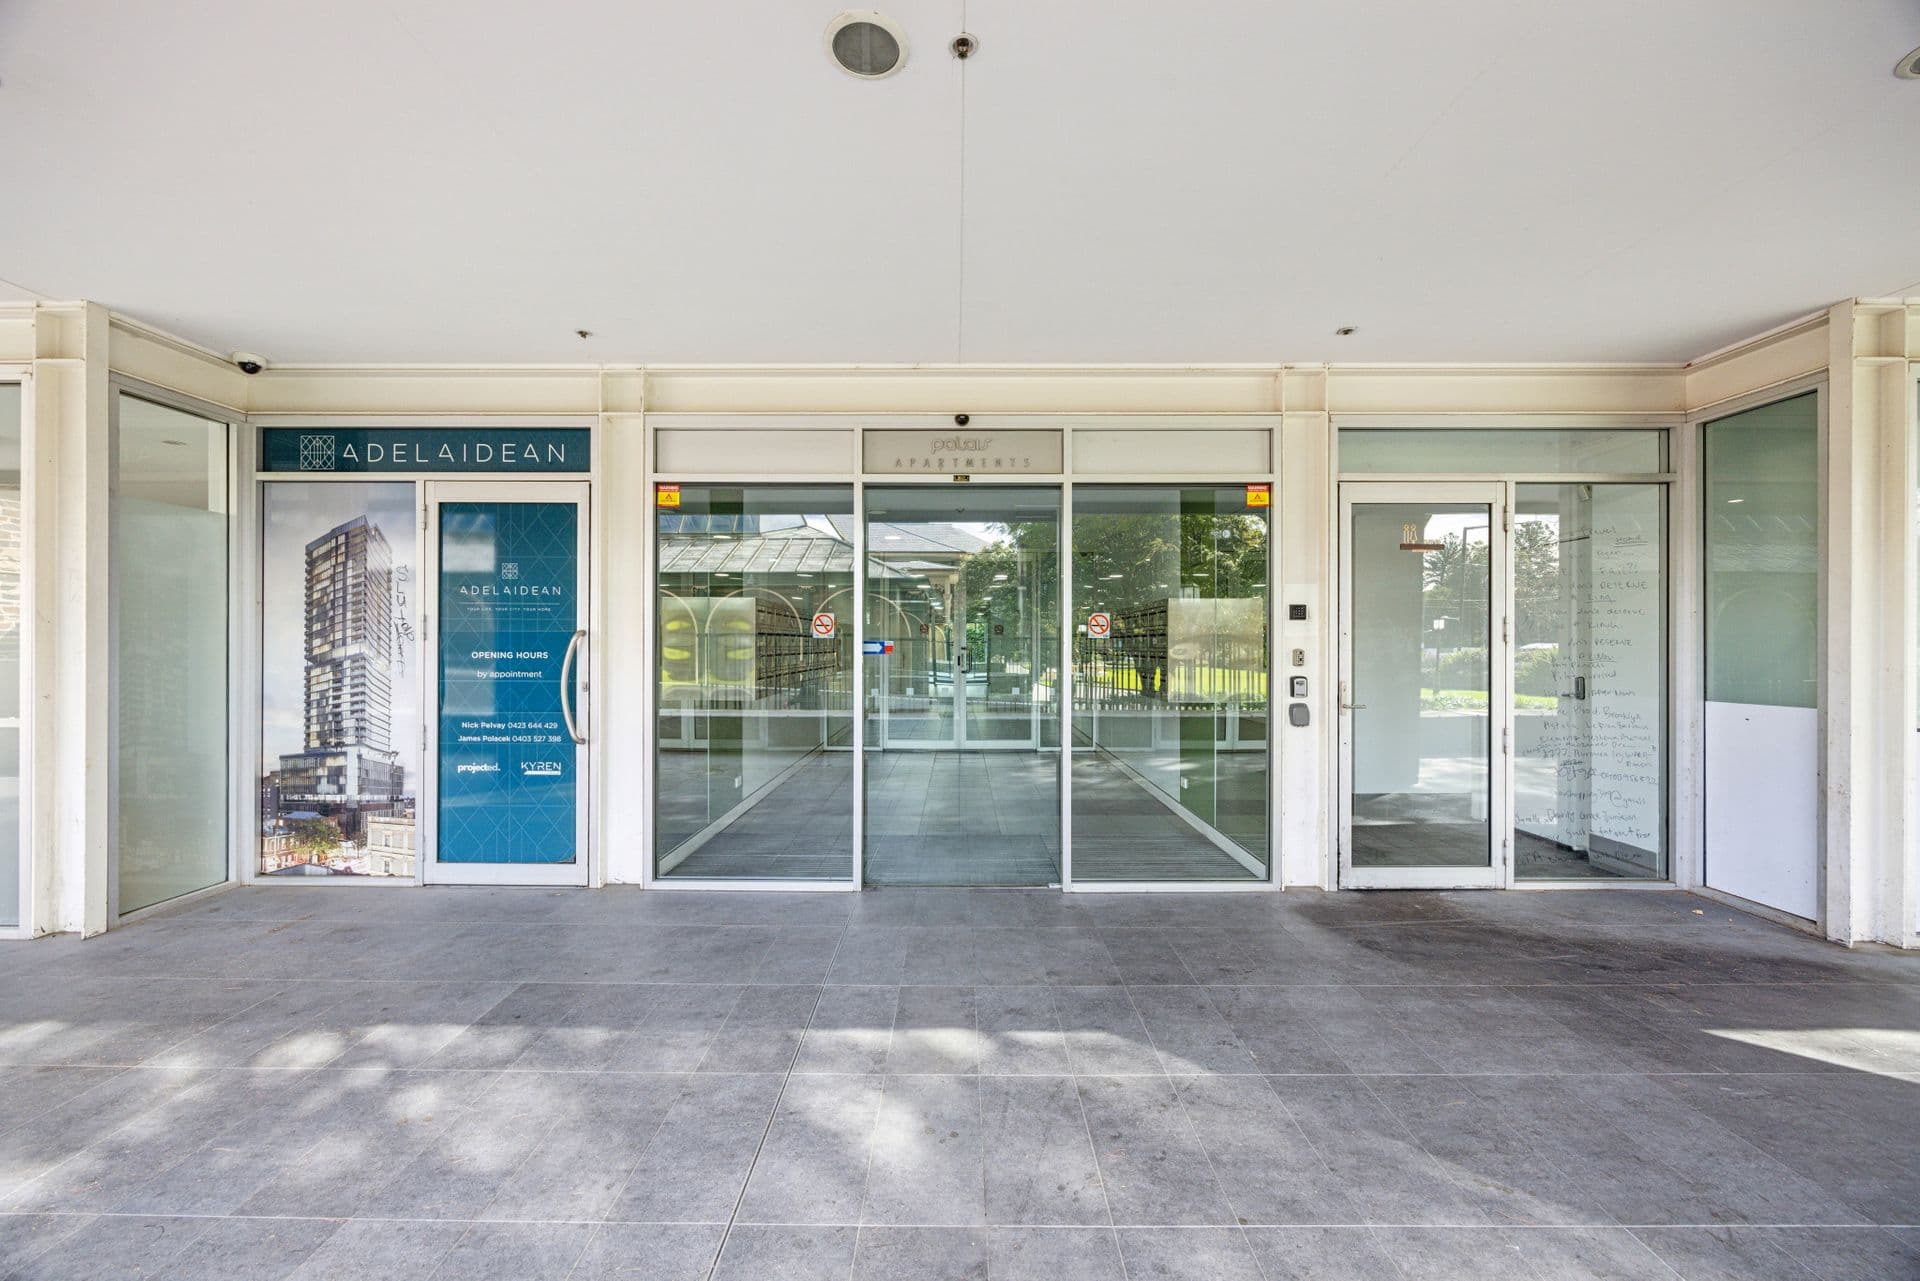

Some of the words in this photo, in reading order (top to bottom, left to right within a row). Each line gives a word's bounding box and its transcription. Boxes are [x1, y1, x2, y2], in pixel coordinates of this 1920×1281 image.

[343, 443, 565, 463] ADELAIDEAN
[895, 457, 1031, 471] APARTMENTS
[459, 585, 562, 596] ADELAIDEAN
[471, 651, 514, 659] OPENING
[516, 651, 549, 659] HOURS
[477, 670, 488, 679] by
[490, 670, 543, 679] appointment
[521, 762, 562, 771] KYREN
